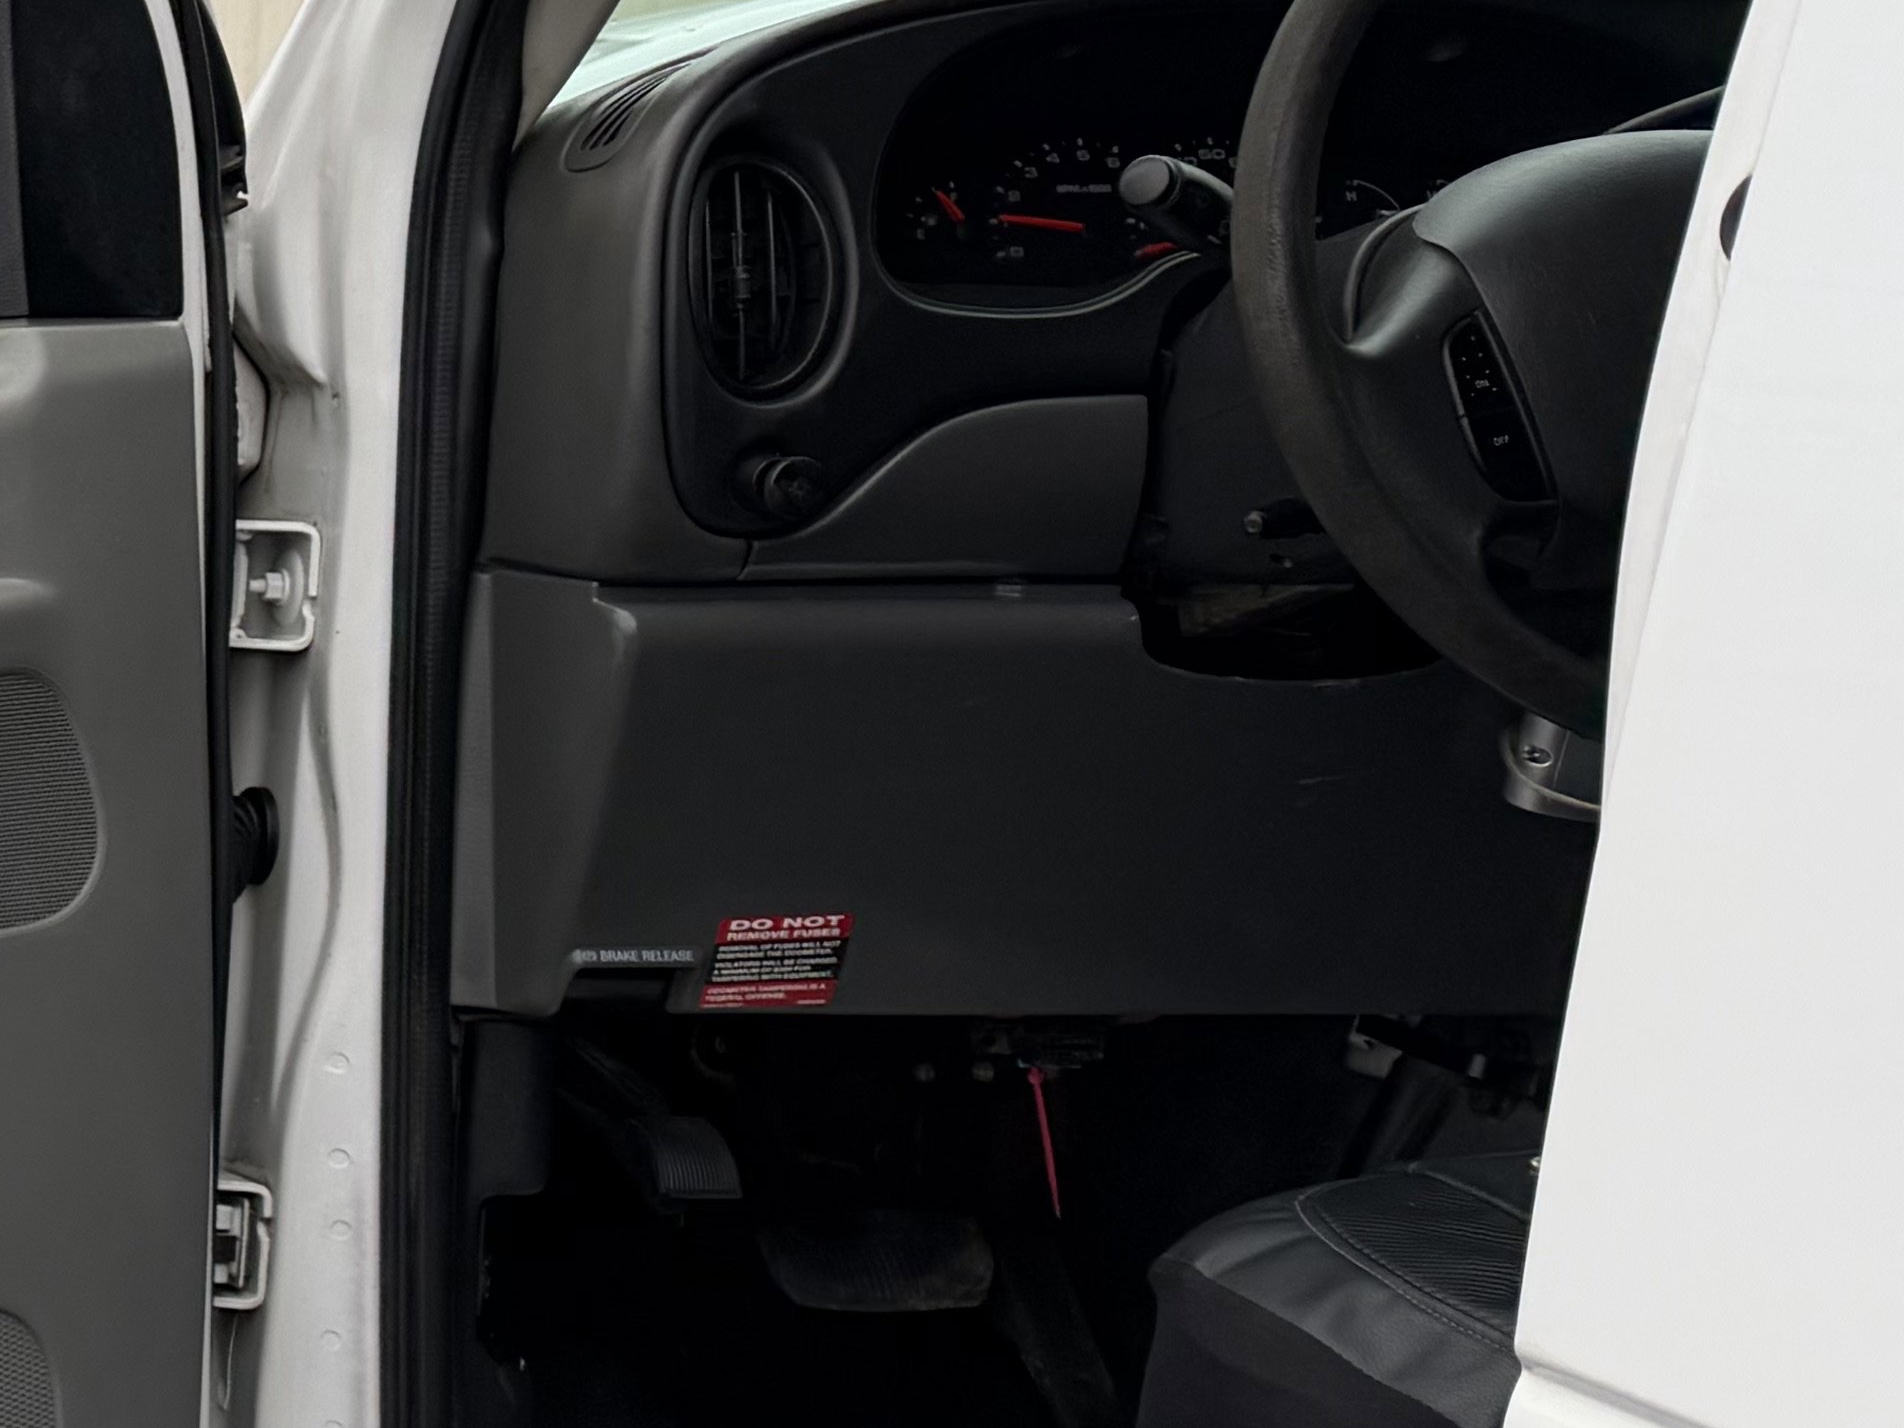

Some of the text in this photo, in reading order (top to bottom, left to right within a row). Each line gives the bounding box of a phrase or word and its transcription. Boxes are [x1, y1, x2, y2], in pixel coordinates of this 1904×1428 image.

[729, 914, 846, 931] DO NOT
[726, 927, 841, 942] REMOVE FUSES
[600, 949, 695, 963] BRAKE RELEASE
